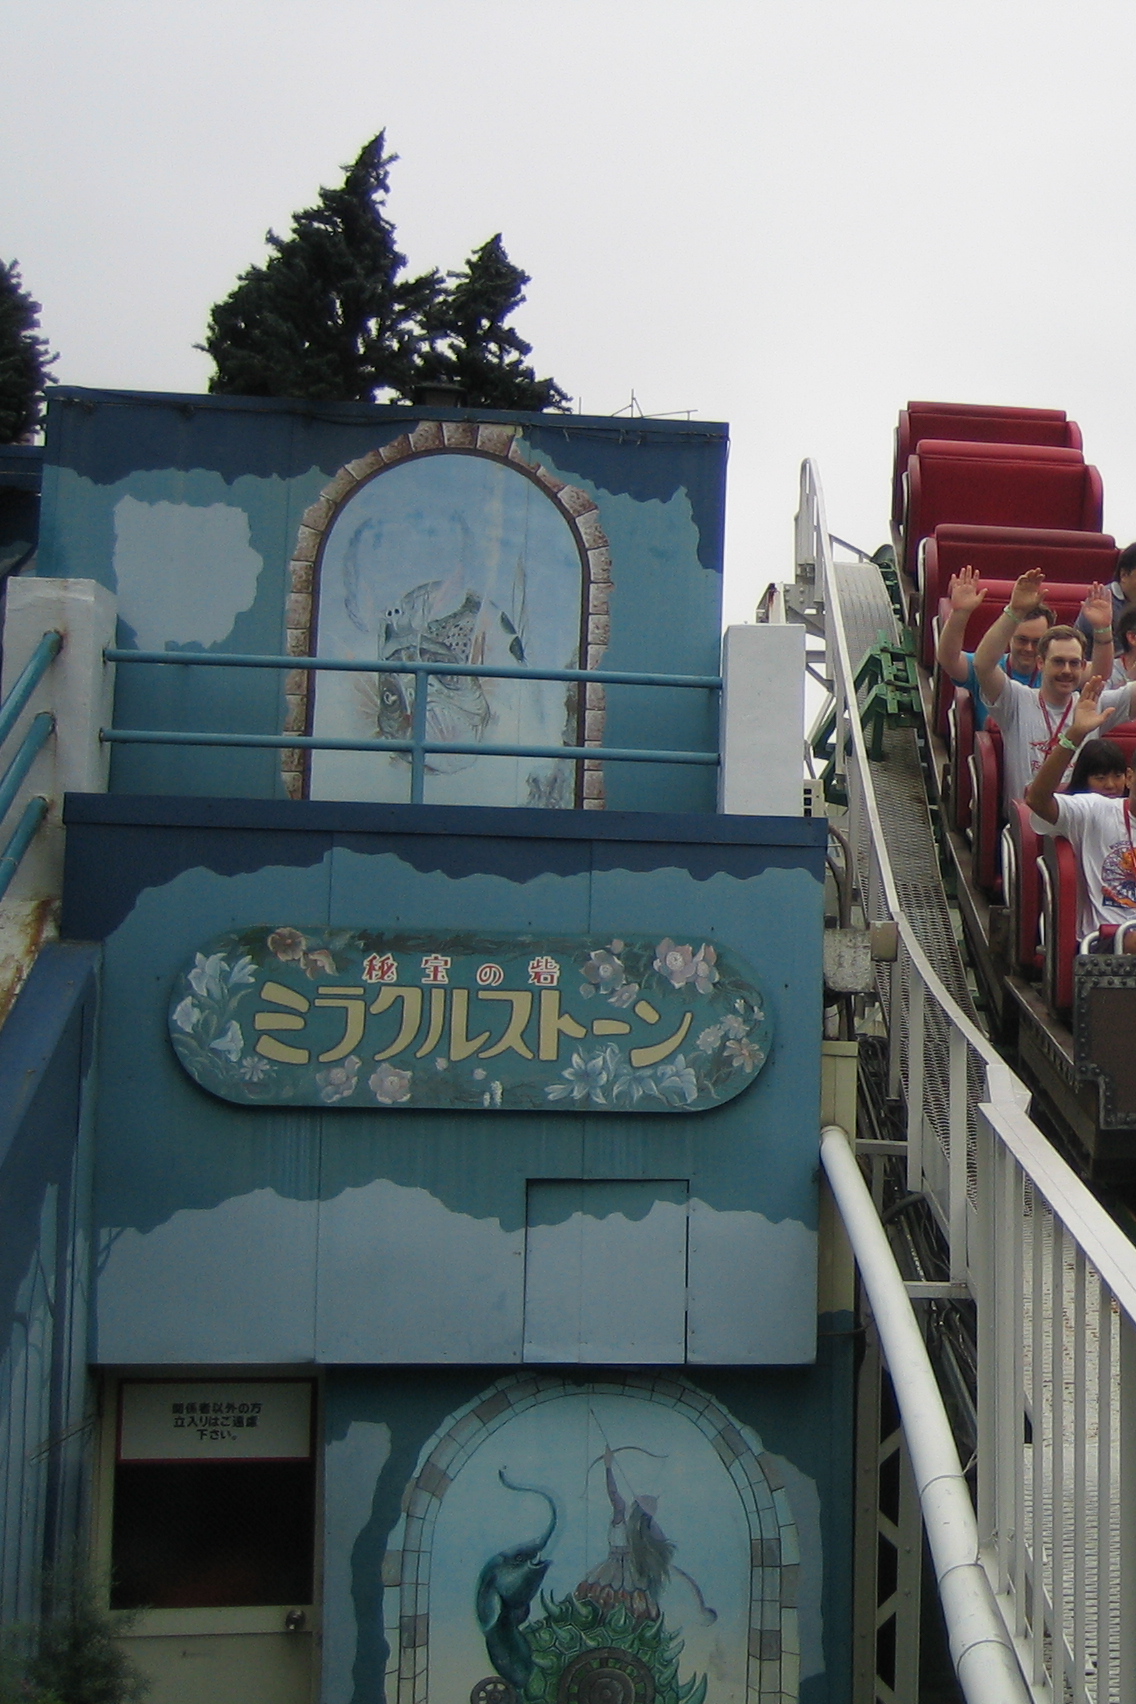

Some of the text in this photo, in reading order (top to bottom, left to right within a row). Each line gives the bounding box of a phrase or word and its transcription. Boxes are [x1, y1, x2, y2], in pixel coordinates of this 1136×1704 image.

[362, 952, 561, 987] 秘宝の砦
[253, 981, 692, 1068] ミラクルストーン
[173, 1402, 262, 1414] 関係者以外の方
[174, 1416, 257, 1427] 立入りはご遠慮
[197, 1429, 237, 1440] 下さい。
